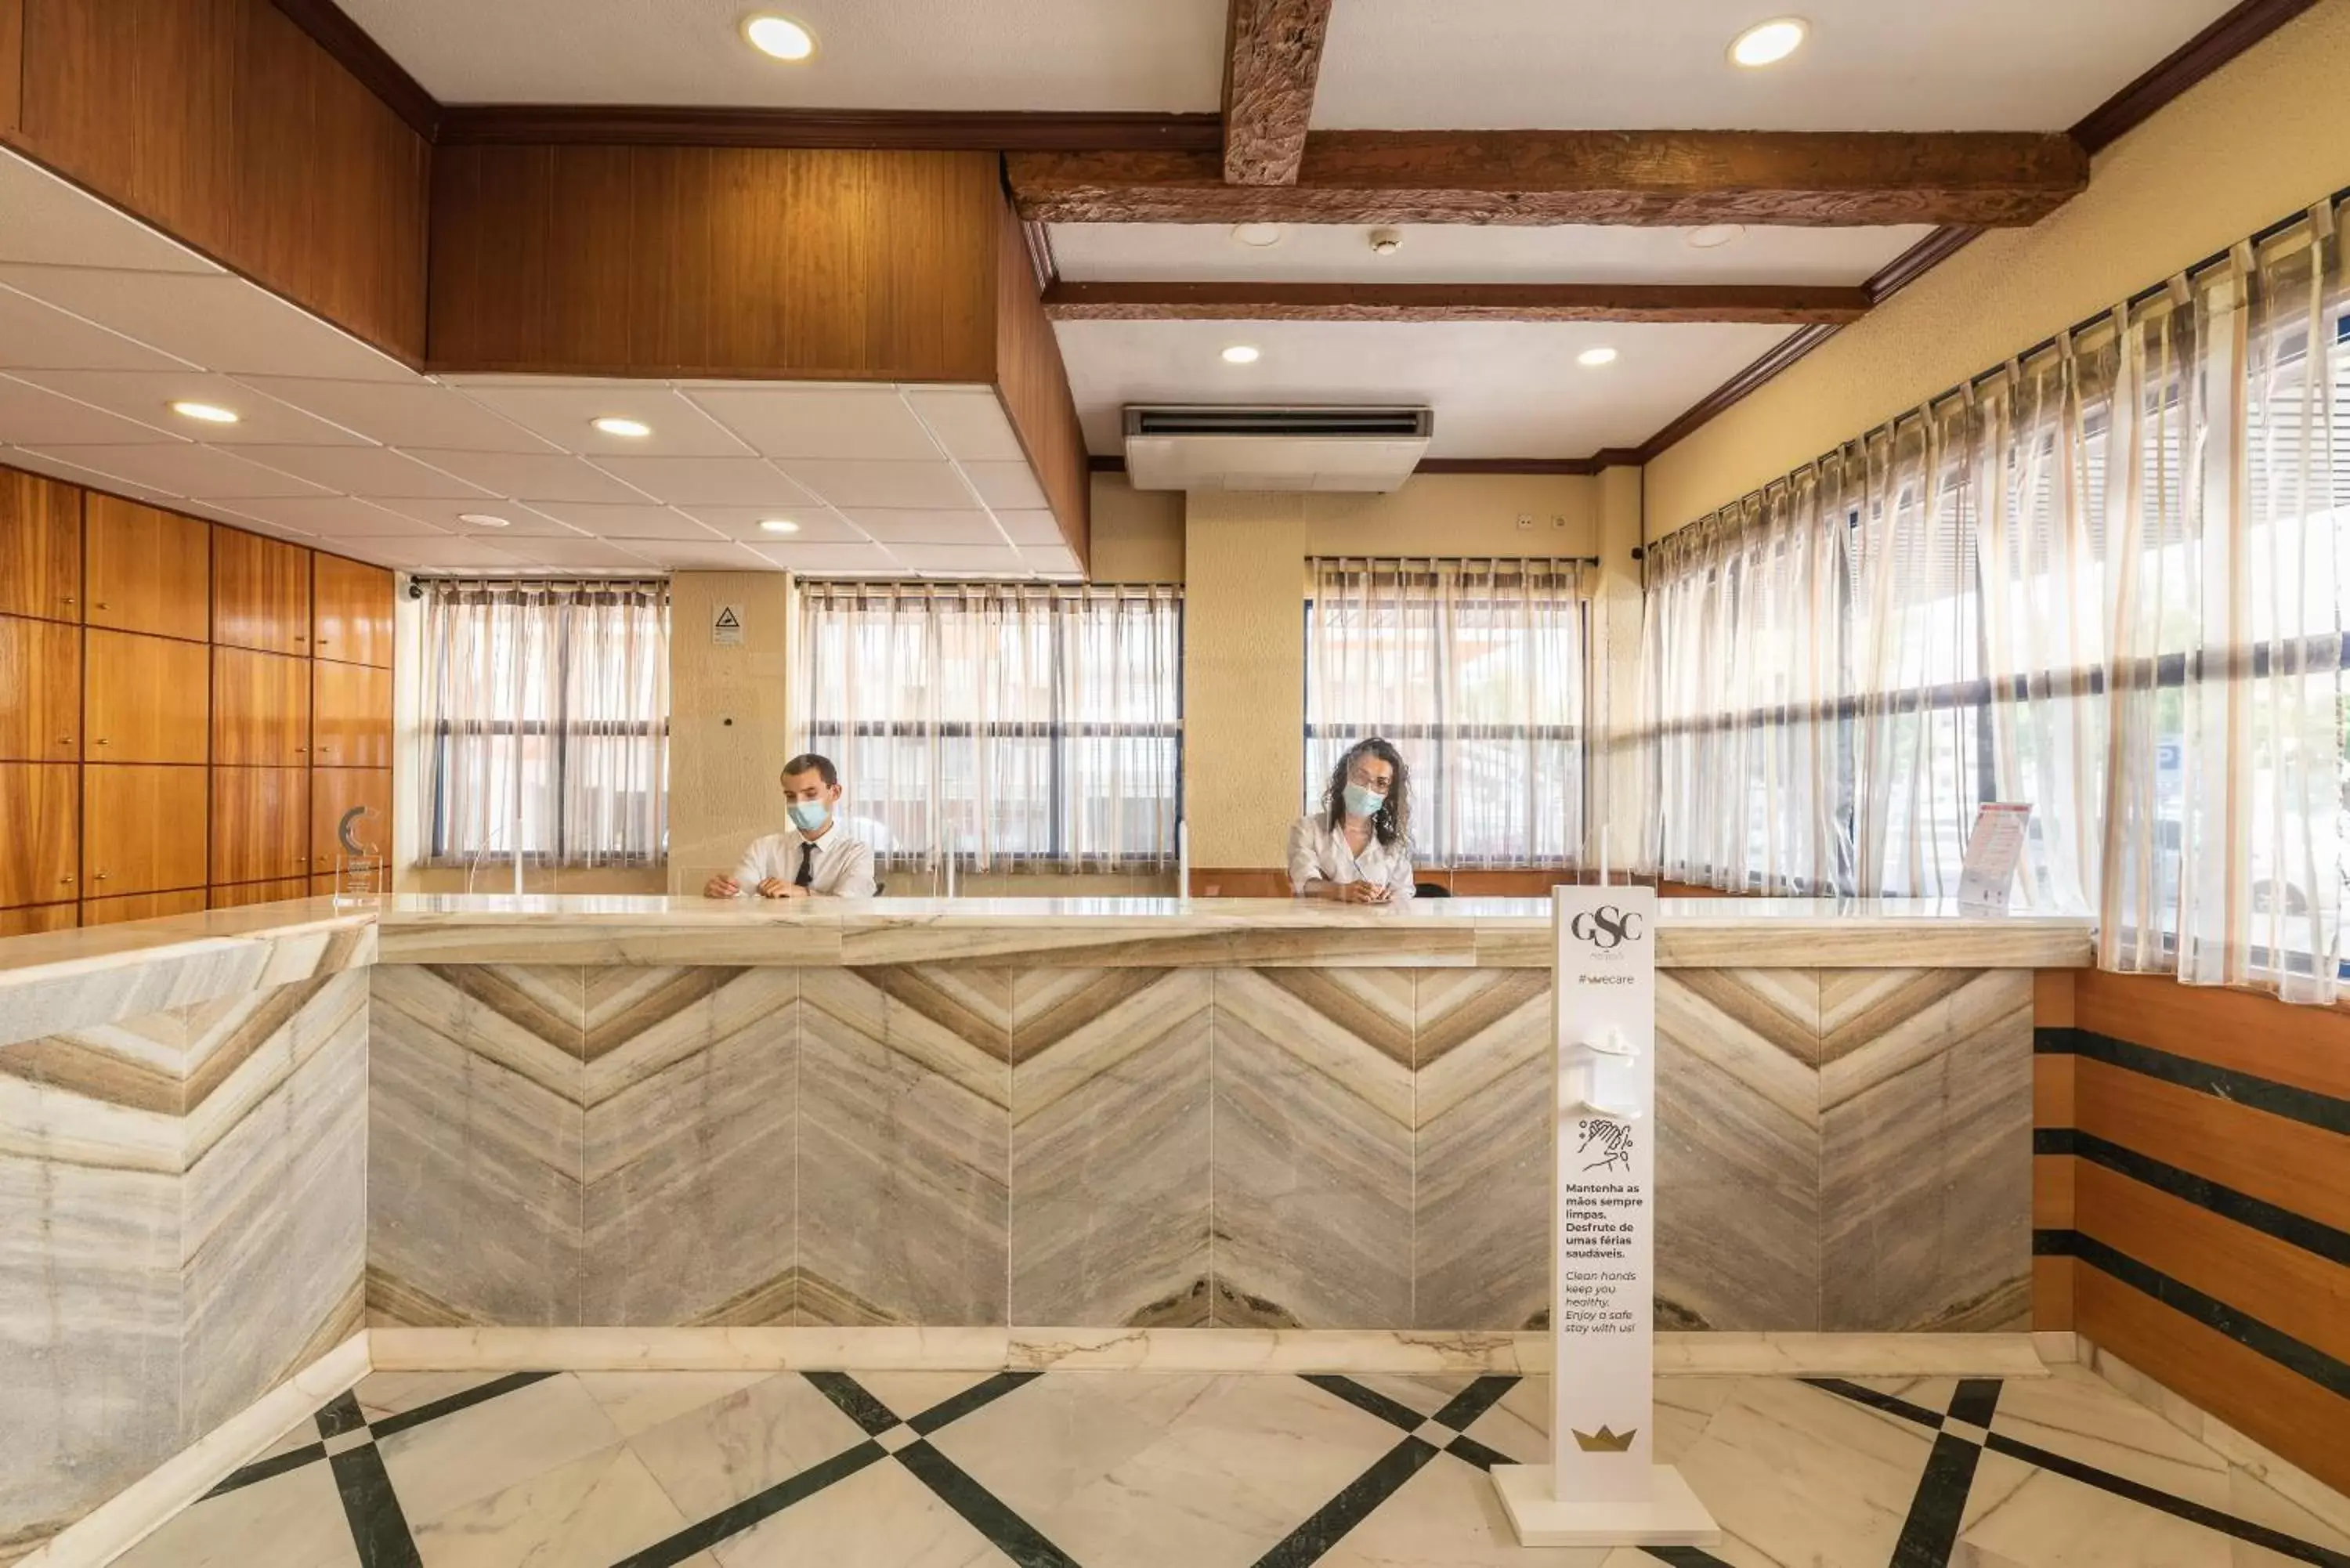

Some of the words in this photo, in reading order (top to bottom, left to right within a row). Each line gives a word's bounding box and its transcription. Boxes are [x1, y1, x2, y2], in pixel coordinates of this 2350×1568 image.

[1571, 905, 1643, 948] GSC
[1566, 1184, 1624, 1193] Mantenha
[1566, 1196, 1597, 1206] mãos
[1600, 1198, 1643, 1209] sempre
[1566, 1209, 1607, 1220] limpas.
[1566, 1223, 1616, 1232] Desfrute
[1619, 1223, 1634, 1232] de
[1600, 1235, 1632, 1245] férias
[1566, 1248, 1625, 1259] saudáveis.
[1566, 1272, 1598, 1281] Clean
[1600, 1271, 1636, 1281] hands
[1566, 1284, 1593, 1295] keep
[1595, 1285, 1616, 1296] you
[1566, 1297, 1610, 1308] healthy.
[1566, 1310, 1596, 1321] Enjoy
[1609, 1310, 1632, 1320] safe
[1566, 1324, 1589, 1335] stay
[1591, 1324, 1616, 1333] with
[1619, 1324, 1636, 1333] us!
